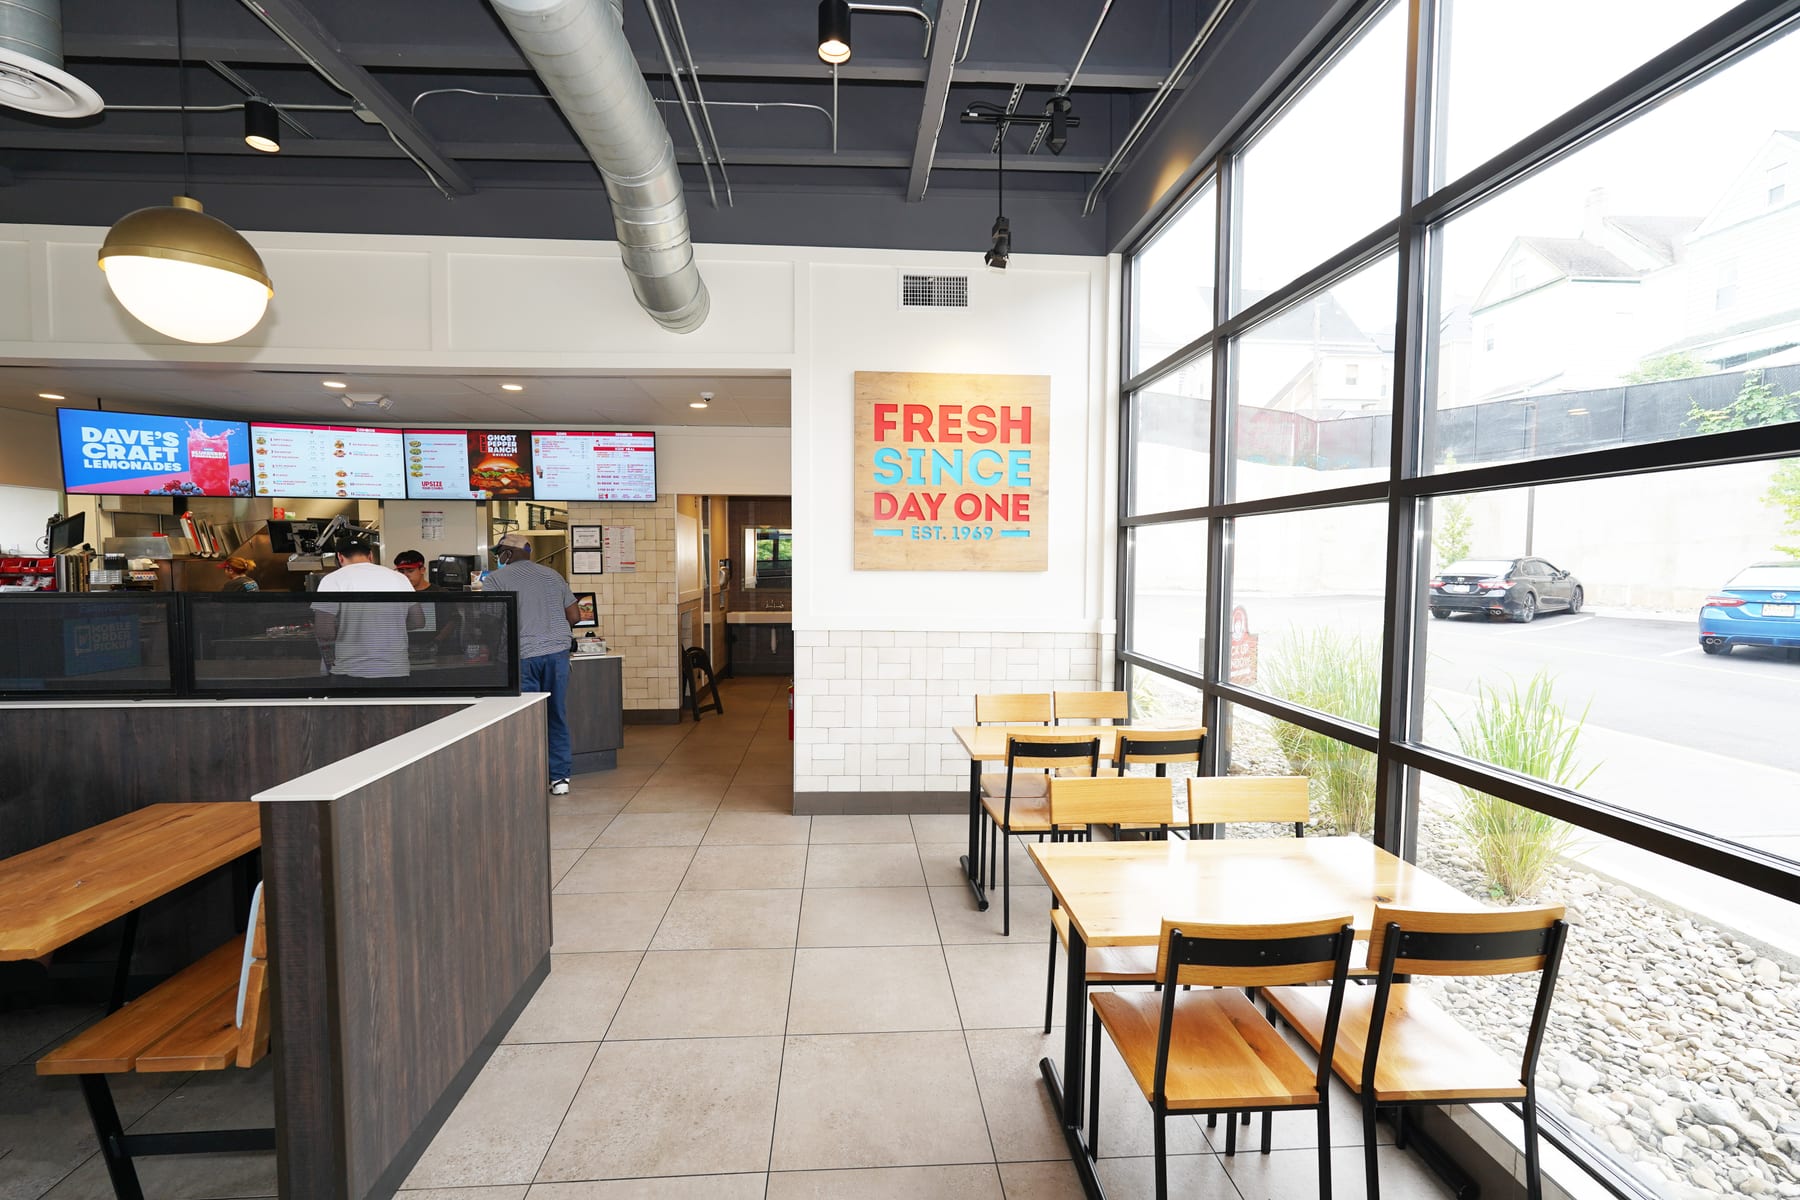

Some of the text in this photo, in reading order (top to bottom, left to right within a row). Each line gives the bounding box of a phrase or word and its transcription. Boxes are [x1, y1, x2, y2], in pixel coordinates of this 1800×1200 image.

[873, 403, 1032, 444] FRESH
[81, 426, 179, 447] DAVE'S
[82, 442, 179, 462] CRAFT
[84, 458, 182, 472] LEMONADES
[873, 447, 1032, 487] SINCE
[873, 492, 1031, 522] DAY ONE
[910, 525, 994, 541] EST. 1969
[93, 631, 130, 641] ORDER
